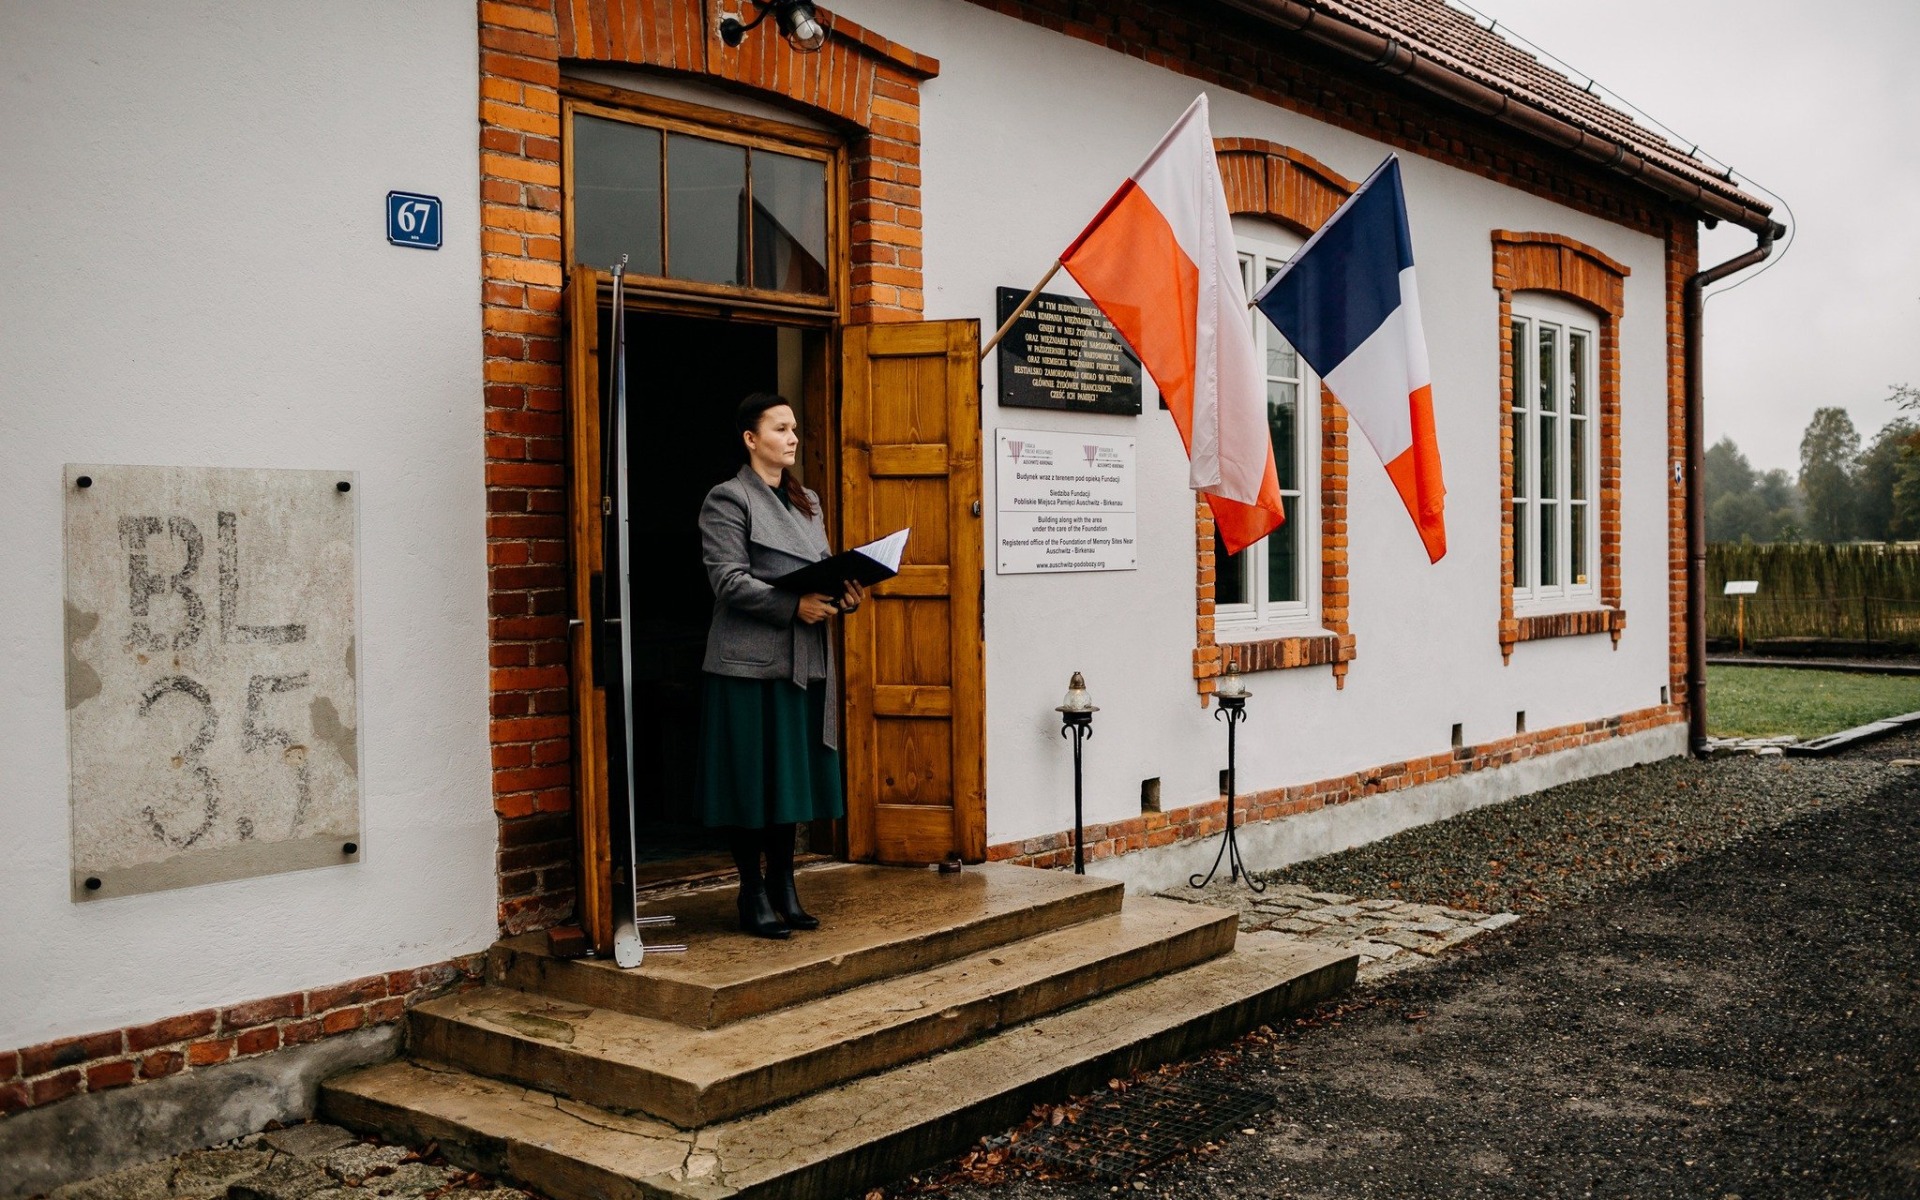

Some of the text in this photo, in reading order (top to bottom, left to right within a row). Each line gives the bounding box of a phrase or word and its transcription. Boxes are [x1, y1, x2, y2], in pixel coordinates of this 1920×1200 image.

[398, 201, 430, 233] 67
[1038, 301, 1044, 309] W
[1045, 302, 1056, 311] TYM
[1038, 312, 1063, 323] KOMPANIA
[1057, 326, 1062, 334] W
[1064, 327, 1075, 336] NIEJ
[1025, 333, 1039, 342] ORAZ
[1070, 339, 1088, 348] INNYCH
[1027, 344, 1032, 352] W
[1067, 349, 1078, 357] 1942
[1027, 355, 1040, 364] ORAZ
[1014, 365, 1043, 375] BESTIALSKO
[1044, 369, 1079, 379] ZAMORDOWALI
[1032, 377, 1054, 387] GŁÓWNIE
[1056, 379, 1079, 389] ŻYDÓWEK
[1050, 389, 1065, 399] CZEŚĆ
[1067, 392, 1076, 400] ICH
[1017, 472, 1038, 481] Budynek
[1101, 476, 1120, 484] Fundacji
[1071, 490, 1090, 498] Fundacji
[1038, 516, 1058, 524] Building
[1059, 516, 1072, 524] along
[1002, 539, 1029, 547] Registered
[1093, 538, 1110, 546] Memory
